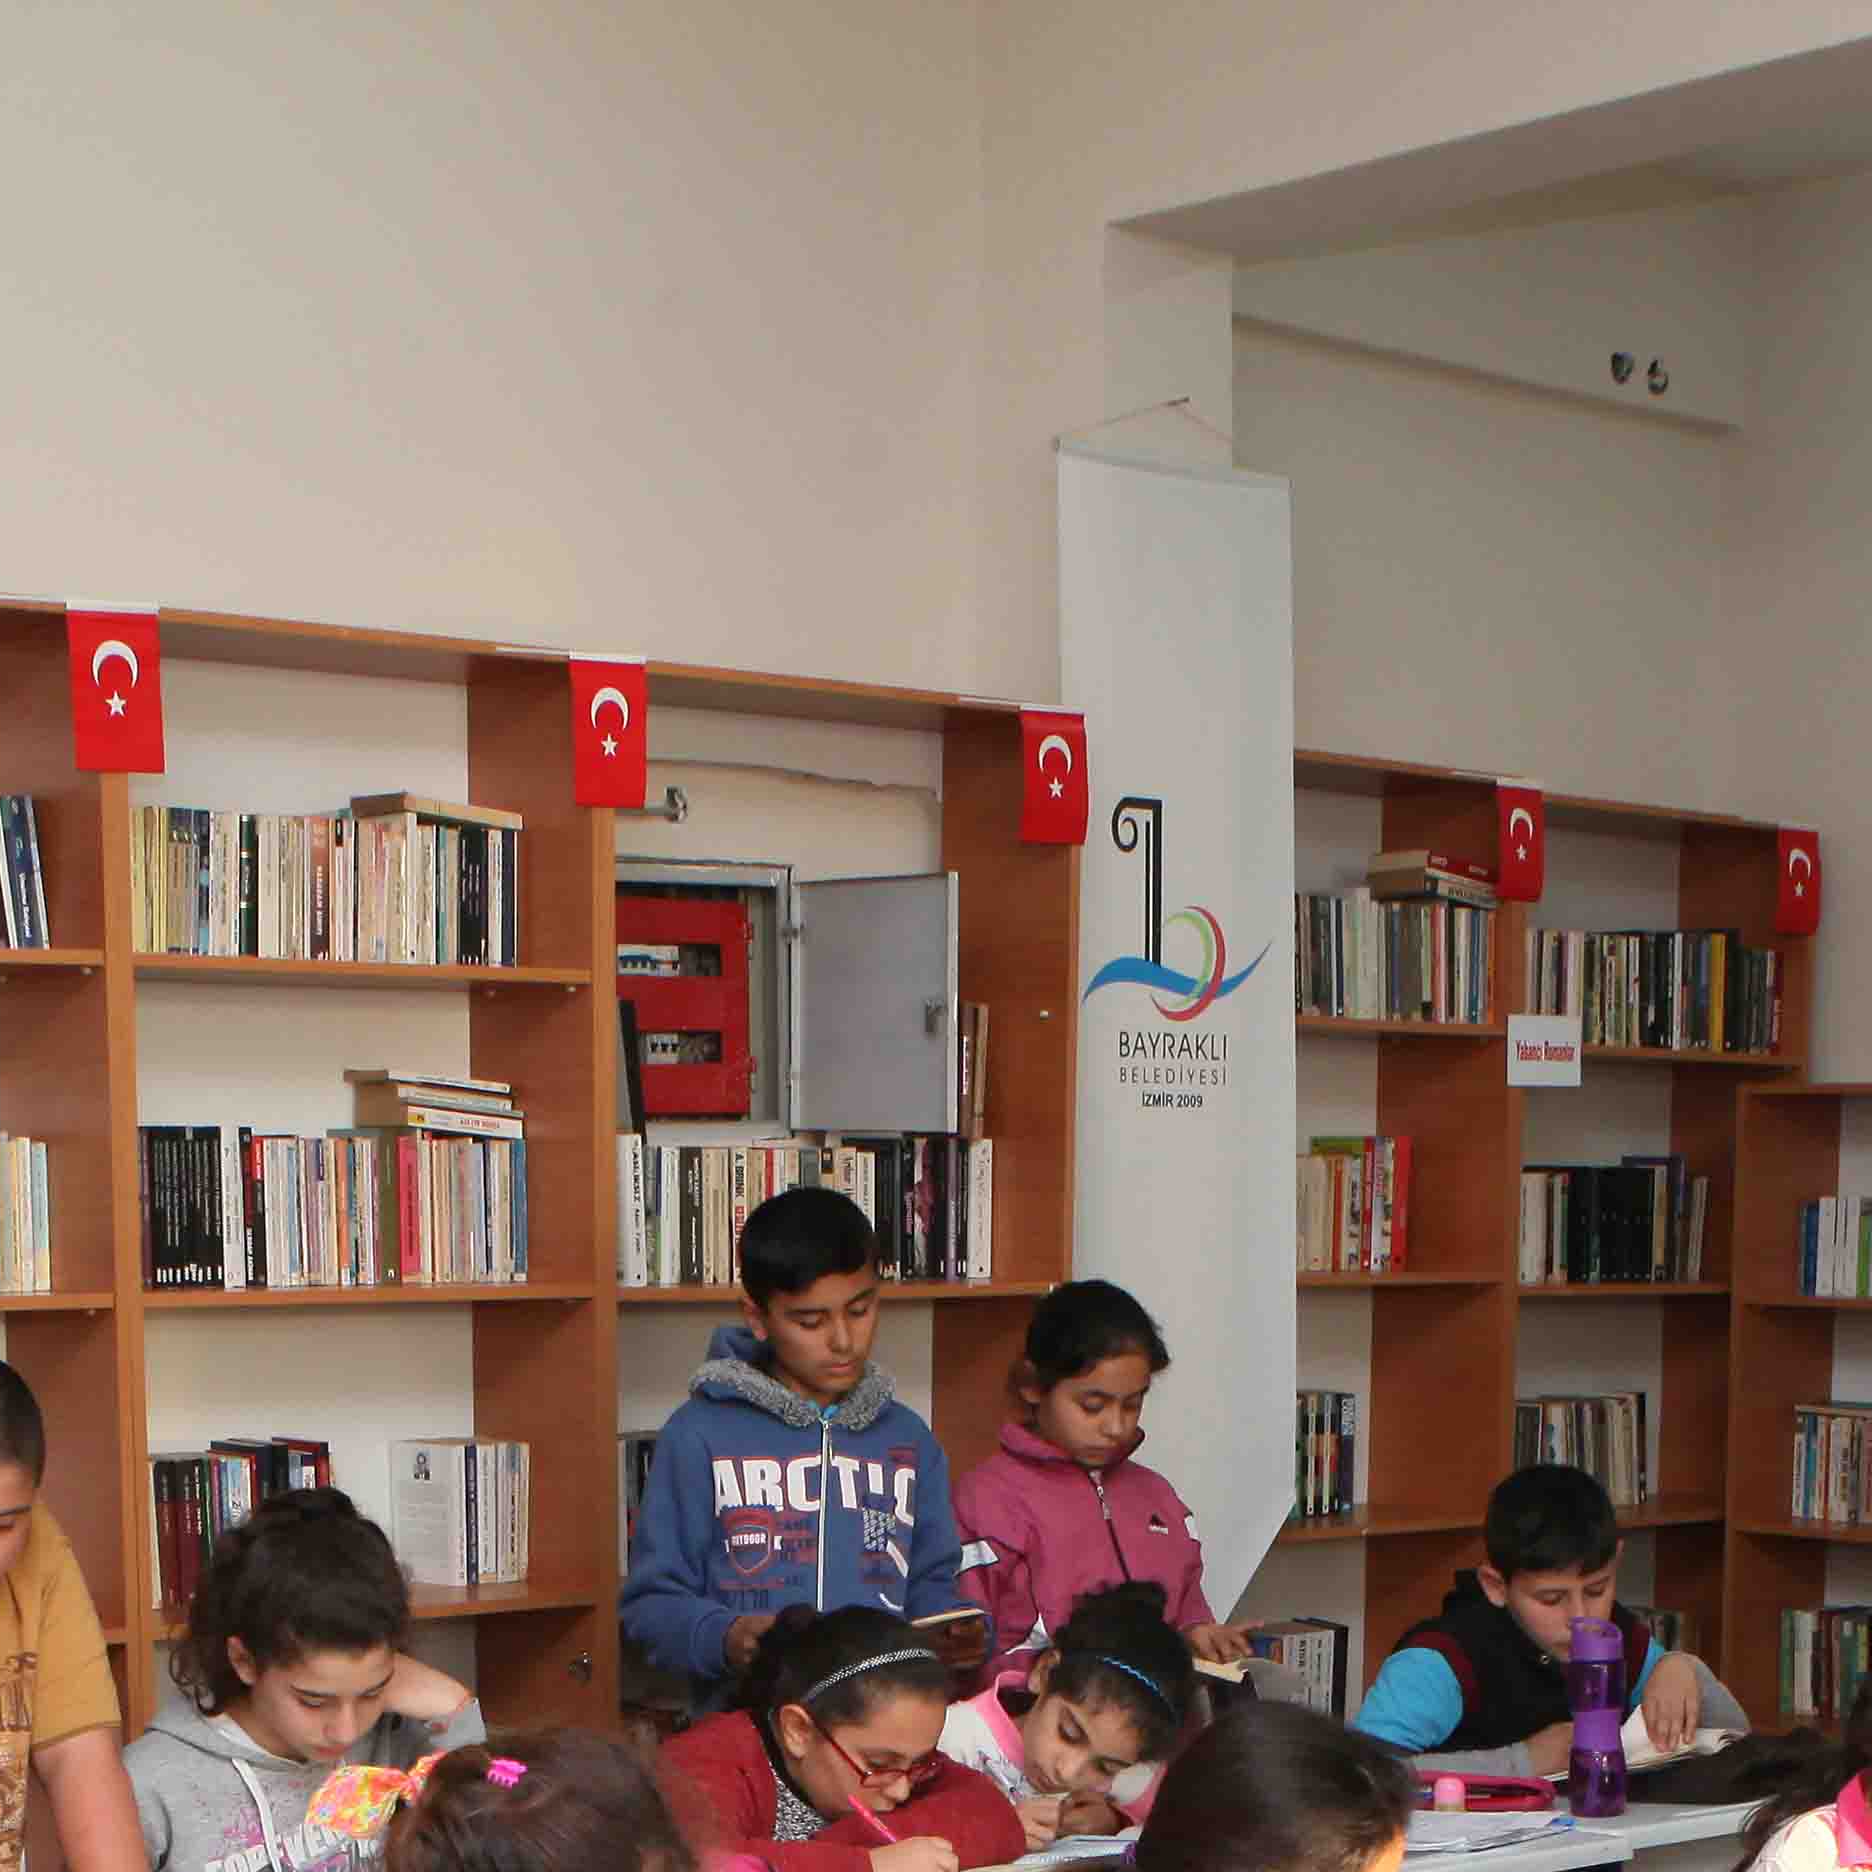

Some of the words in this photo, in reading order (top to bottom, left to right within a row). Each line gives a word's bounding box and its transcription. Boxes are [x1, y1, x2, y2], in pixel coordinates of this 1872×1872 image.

[1118, 1031, 1227, 1061] BAYRAKLI
[1119, 1064, 1227, 1086] BELEDİYESİ
[1142, 1090, 1174, 1108] İZMİR
[1176, 1093, 1204, 1108] 2009
[711, 1454, 917, 1528] ARCTIC
